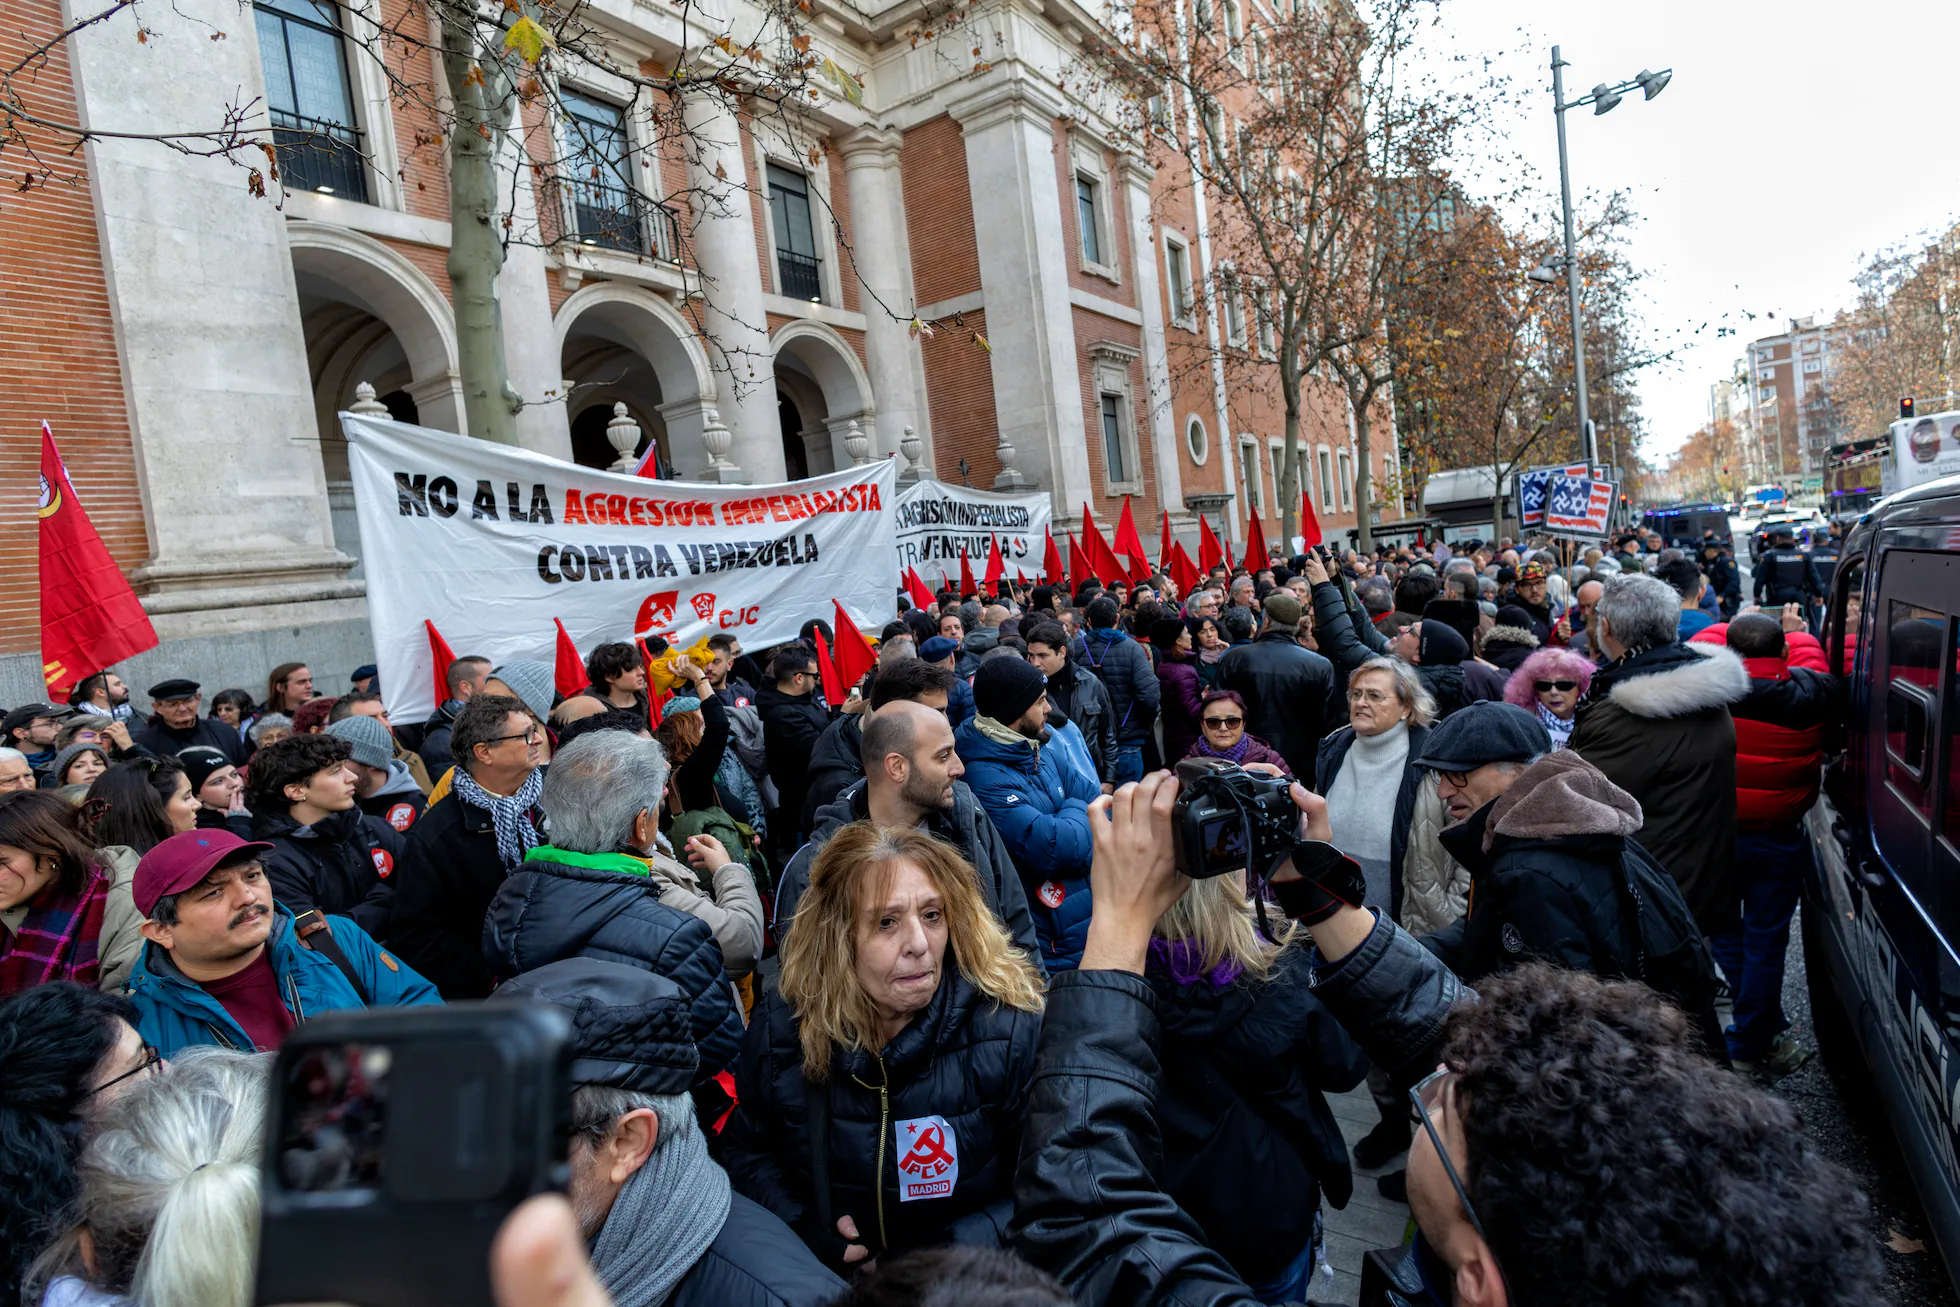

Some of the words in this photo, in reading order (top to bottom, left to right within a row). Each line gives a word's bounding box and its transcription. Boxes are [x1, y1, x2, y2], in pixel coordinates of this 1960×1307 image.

[394, 472, 458, 518] NO
[472, 480, 500, 521] A
[506, 482, 555, 524] LA
[721, 483, 882, 526] IMPERIALISTA
[958, 502, 1029, 527] IMPERIALISTA
[537, 543, 678, 584] CONTRA
[677, 533, 819, 575] VENEZUELA
[922, 535, 1010, 561] VENEZUEA
[719, 605, 760, 629] CJC
[1200, 807, 1218, 816] Canon
[906, 1157, 949, 1179] PCE
[909, 1182, 949, 1195] MADRID
